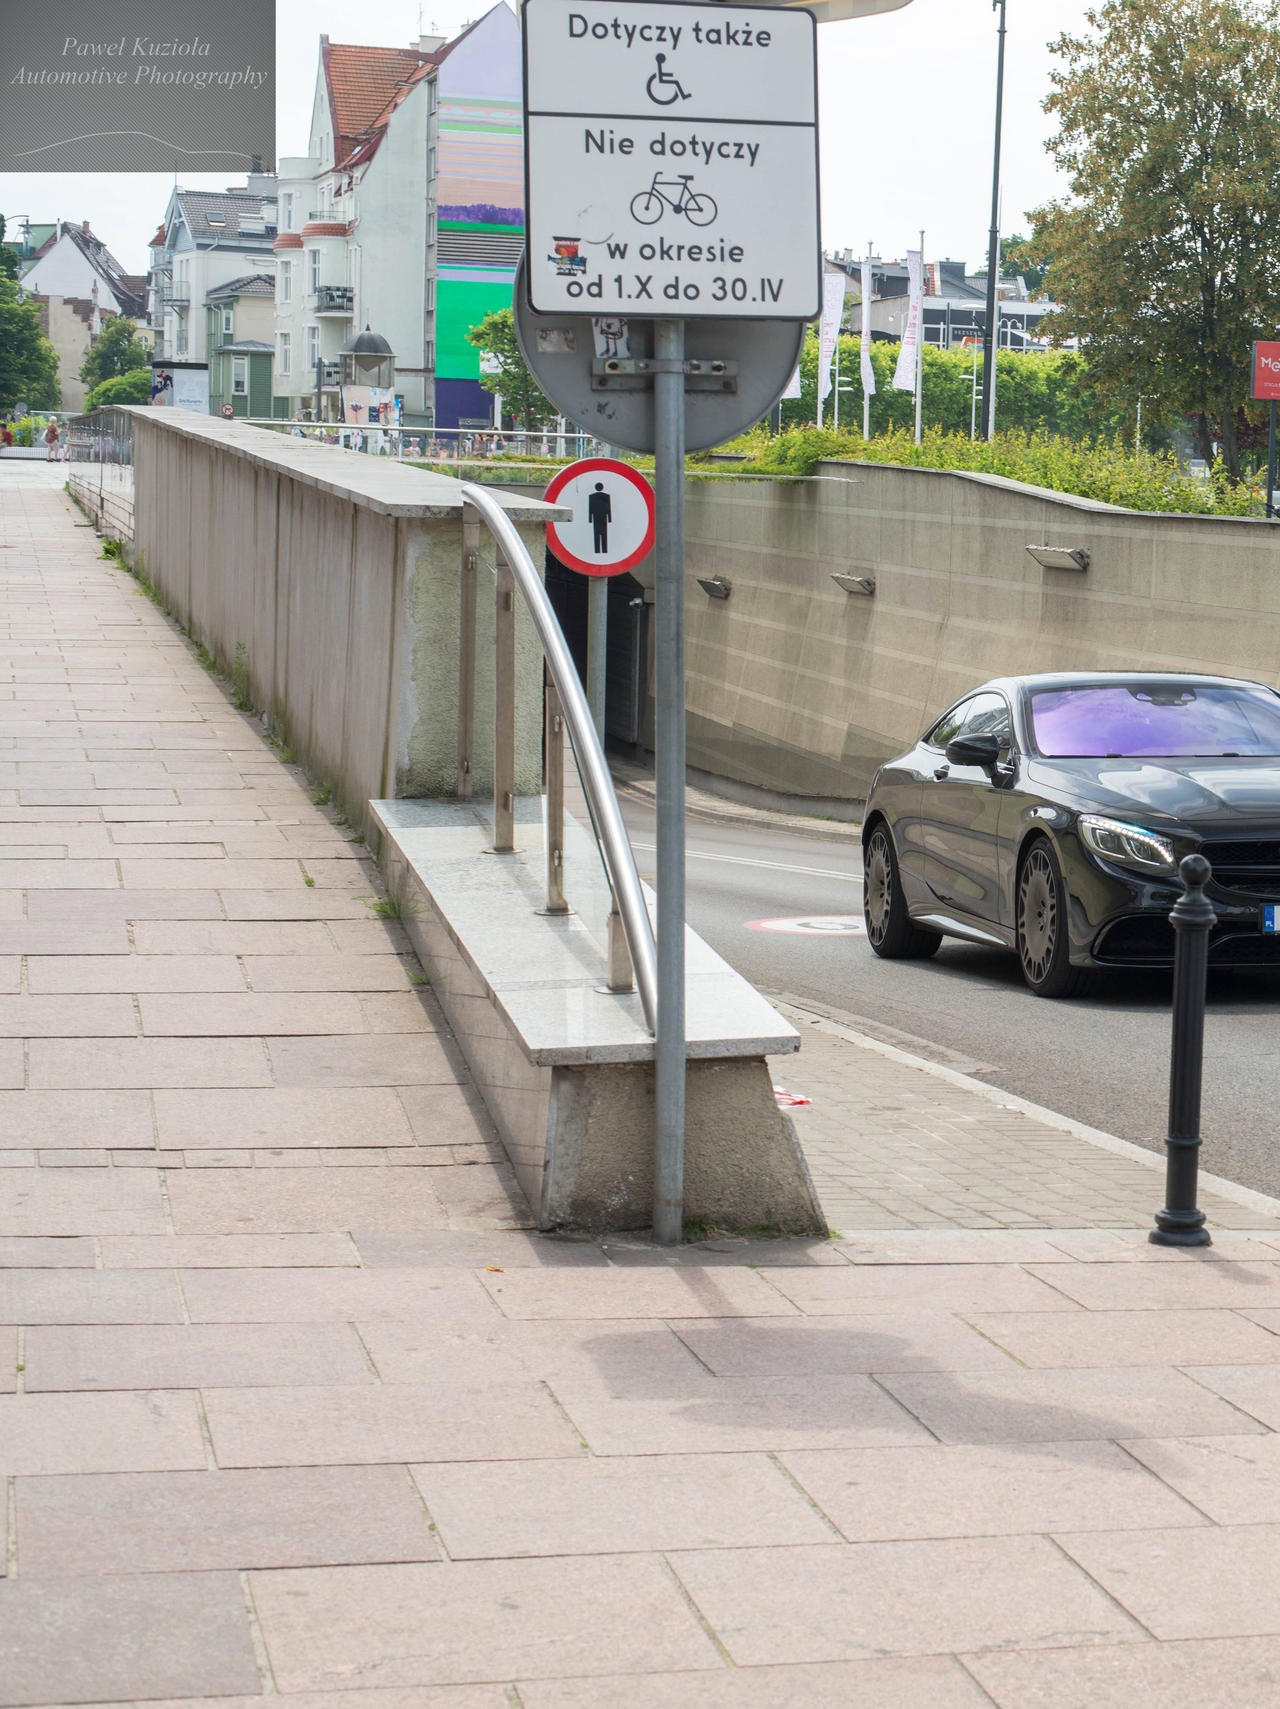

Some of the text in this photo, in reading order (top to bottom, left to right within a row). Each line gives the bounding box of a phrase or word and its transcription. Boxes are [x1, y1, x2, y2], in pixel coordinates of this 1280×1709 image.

[568, 14, 772, 50] Dotyczy także
[584, 129, 760, 167] Nie dotyczy
[607, 242, 629, 260] w
[638, 236, 745, 263] okresie
[566, 274, 784, 303] od 1.X do 30.IV
